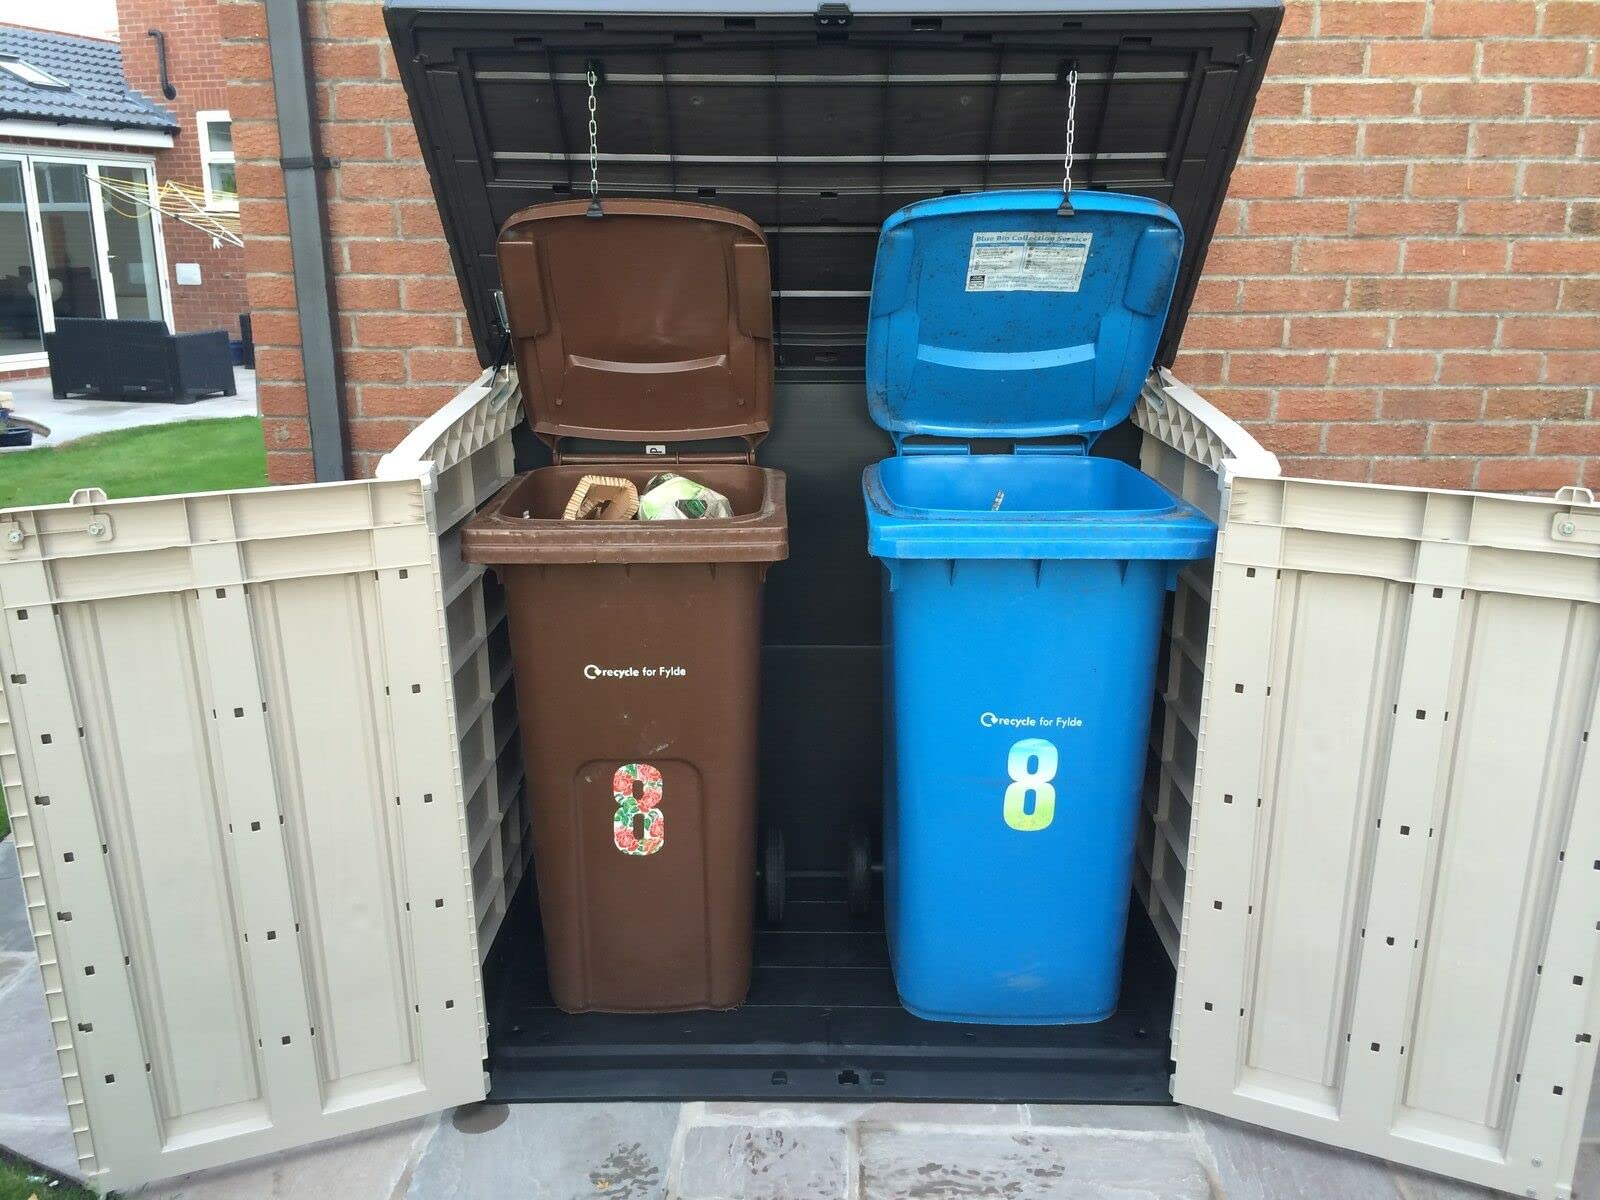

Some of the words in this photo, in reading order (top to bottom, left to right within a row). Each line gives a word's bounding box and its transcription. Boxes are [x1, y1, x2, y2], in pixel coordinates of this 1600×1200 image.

[602, 666, 640, 679] recycle
[642, 666, 656, 677] for
[659, 666, 687, 679] Fylde
[998, 716, 1036, 728] recycle
[1039, 716, 1053, 727] for
[1056, 716, 1083, 729] Fylde
[613, 763, 664, 856] 8
[1003, 737, 1059, 832] 8
